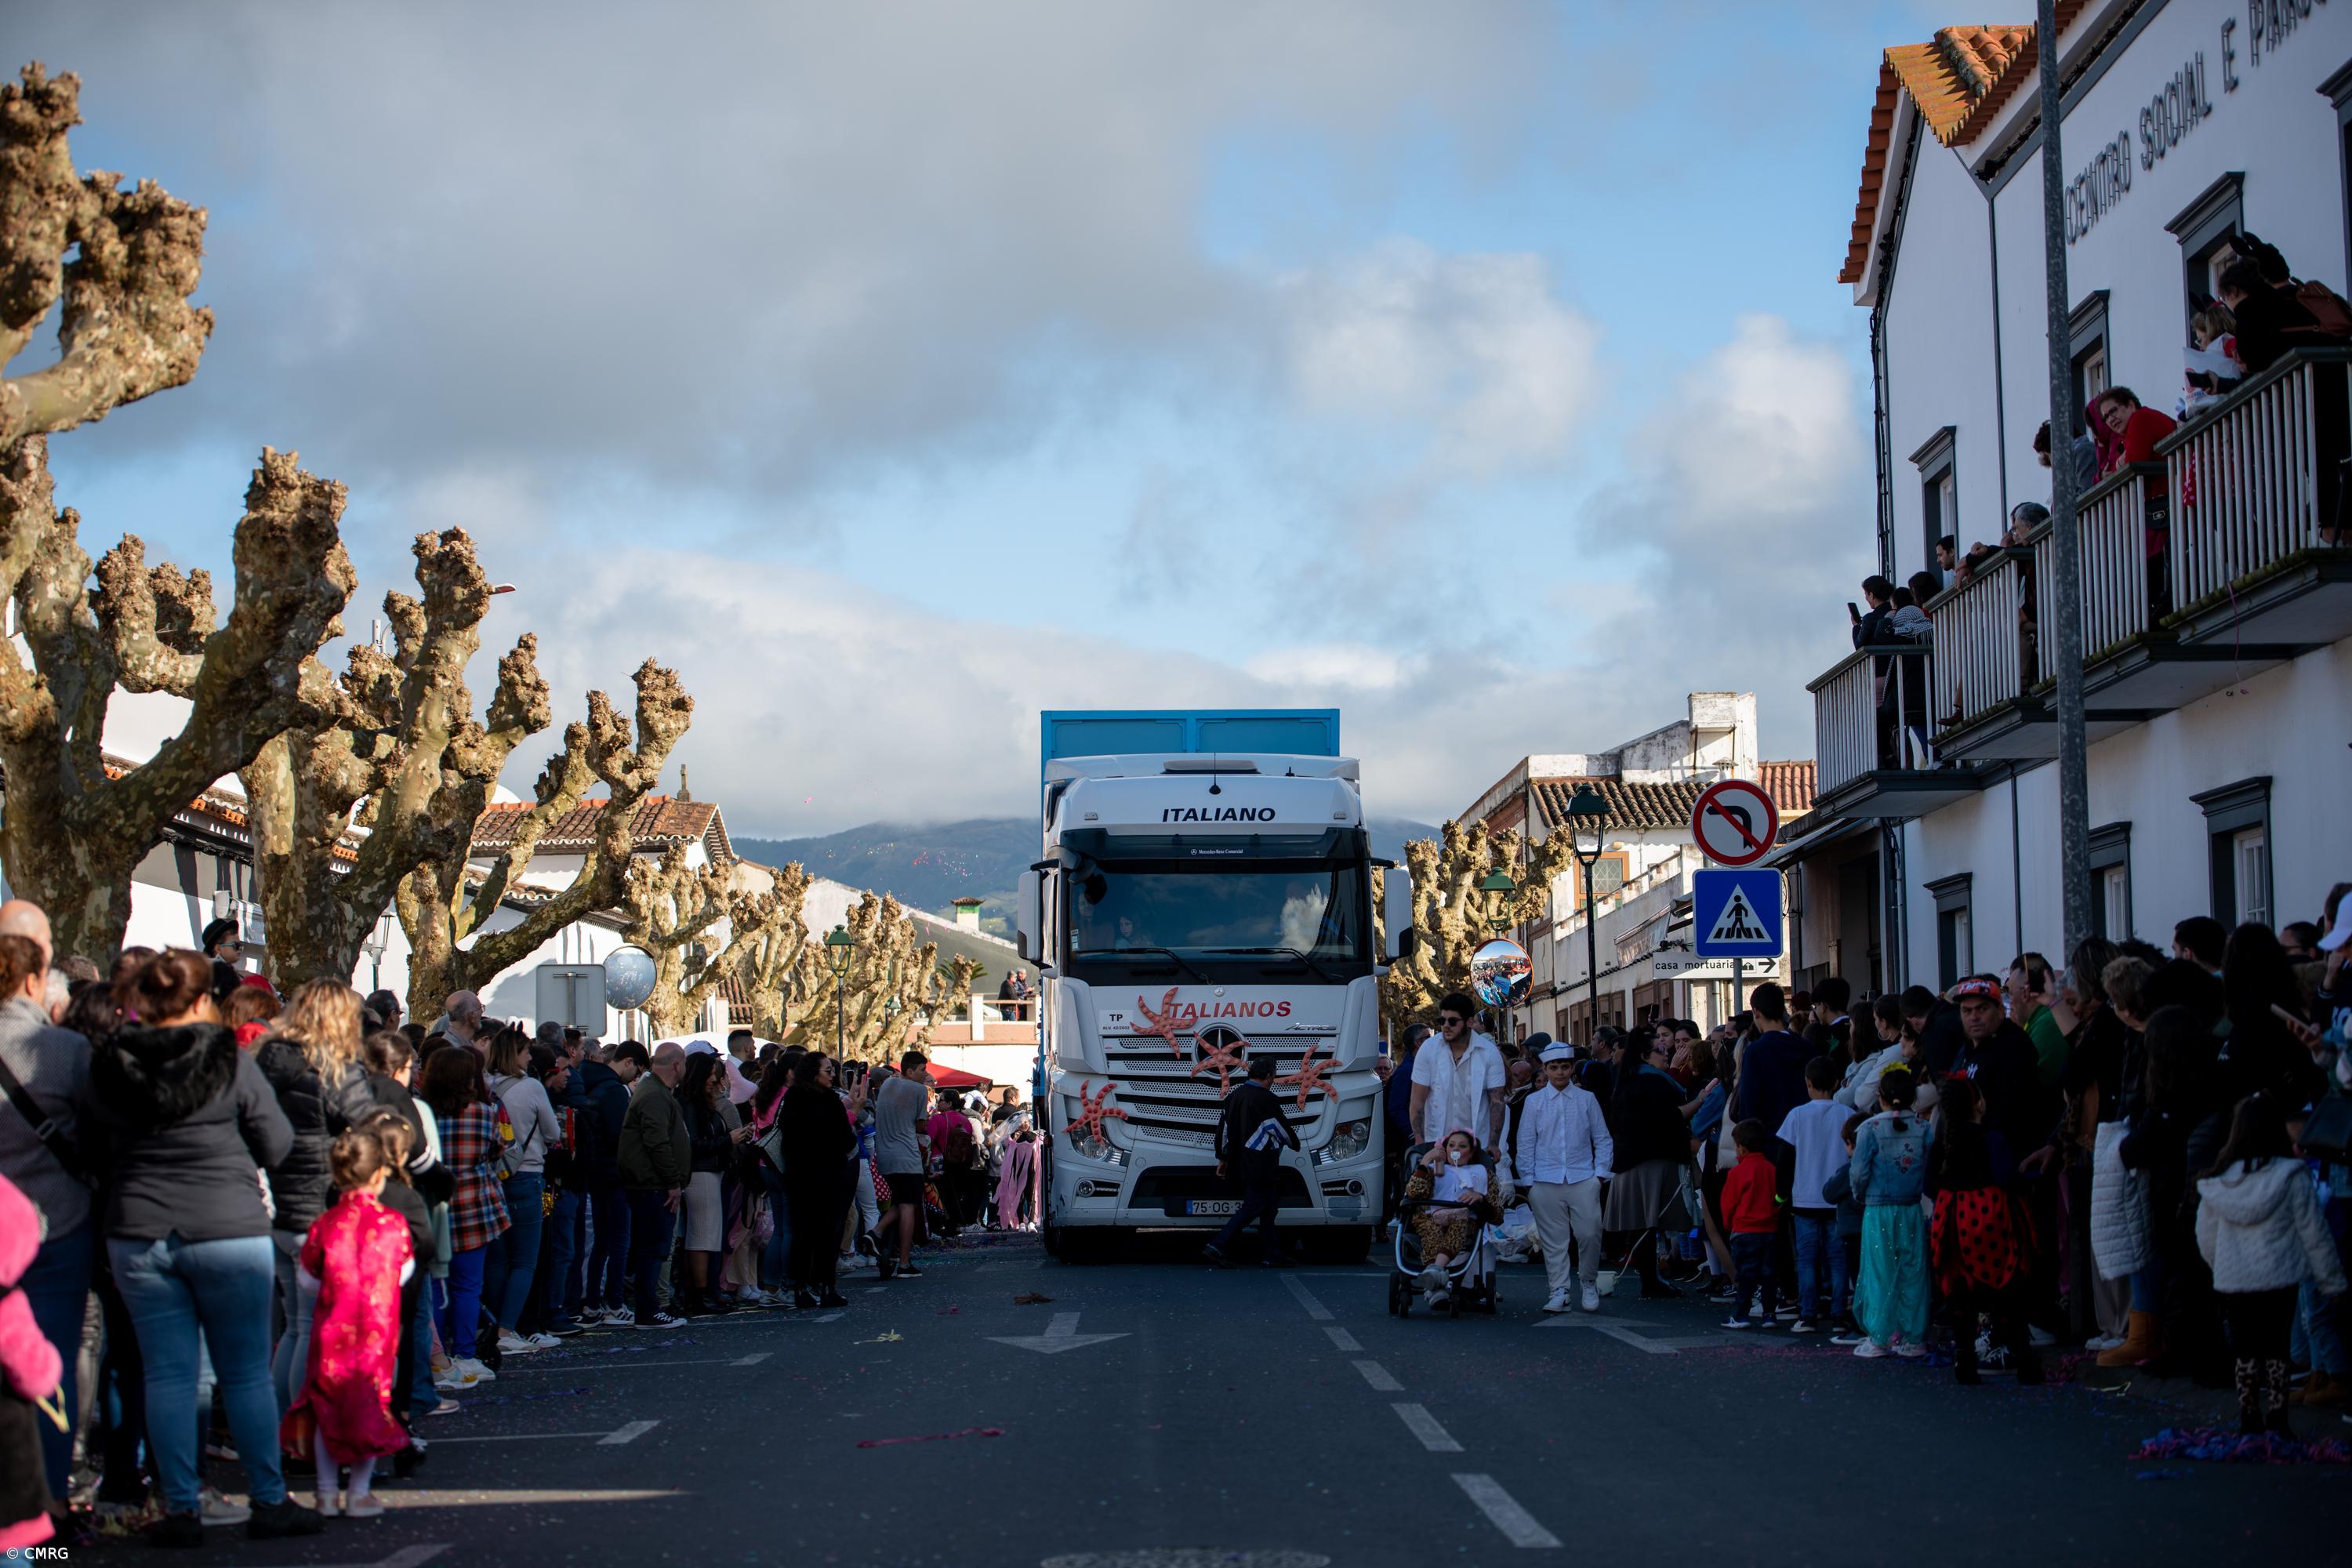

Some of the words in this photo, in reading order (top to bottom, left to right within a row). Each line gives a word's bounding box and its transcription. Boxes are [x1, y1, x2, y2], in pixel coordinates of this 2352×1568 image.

[2064, 130, 2132, 245] CENTRO
[2140, 51, 2212, 172] SOCIAL
[2221, 17, 2239, 94] E
[1162, 808, 1276, 822] ITALIANO
[1685, 960, 1734, 969] mortuária
[1169, 1001, 1292, 1018] TALIANOS
